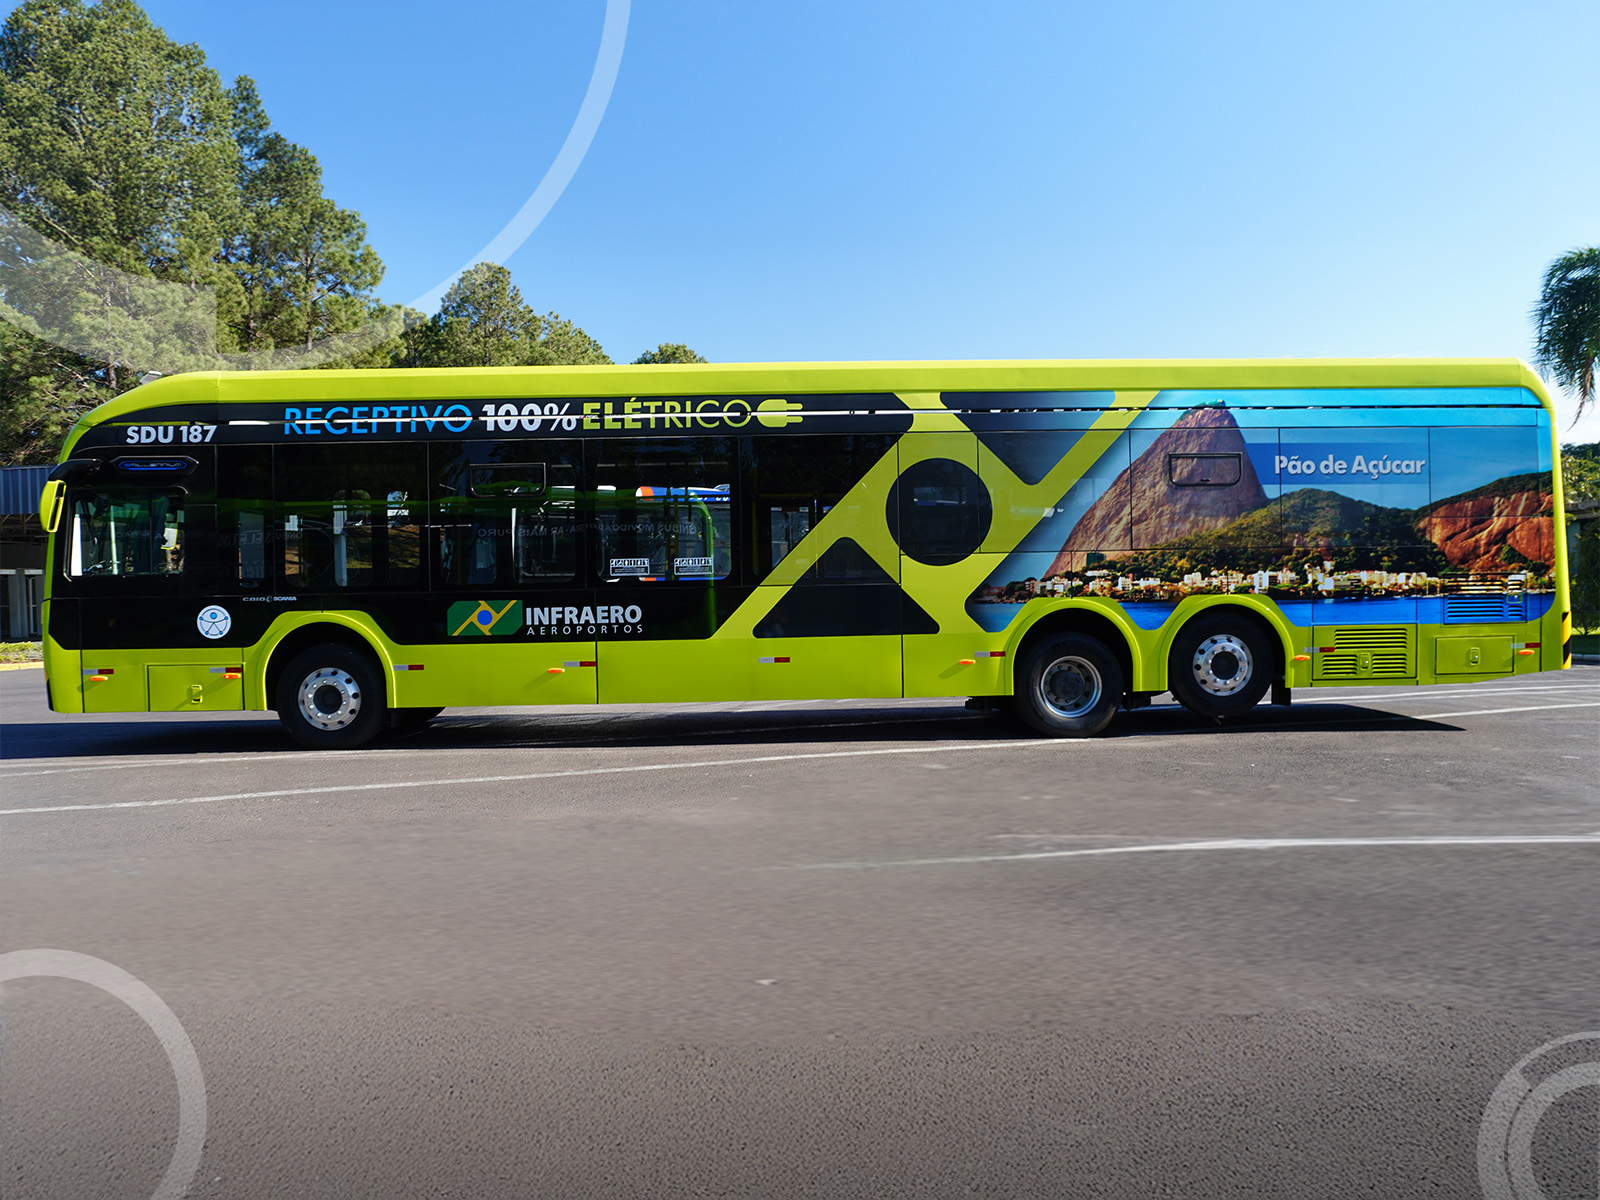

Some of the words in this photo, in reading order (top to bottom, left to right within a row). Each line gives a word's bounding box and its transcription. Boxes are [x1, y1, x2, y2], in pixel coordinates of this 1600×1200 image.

[284, 404, 473, 436] RECEPTIVO
[482, 402, 577, 432] 100%
[582, 397, 753, 431] ELÉTRICO
[126, 425, 174, 444] SDU
[179, 425, 218, 444] 187
[1274, 455, 1316, 475] Pão
[1319, 454, 1348, 475] de
[1351, 454, 1427, 480] Açúcar
[526, 604, 642, 626] INFRAERO
[526, 624, 643, 636] AEROPORTOS
